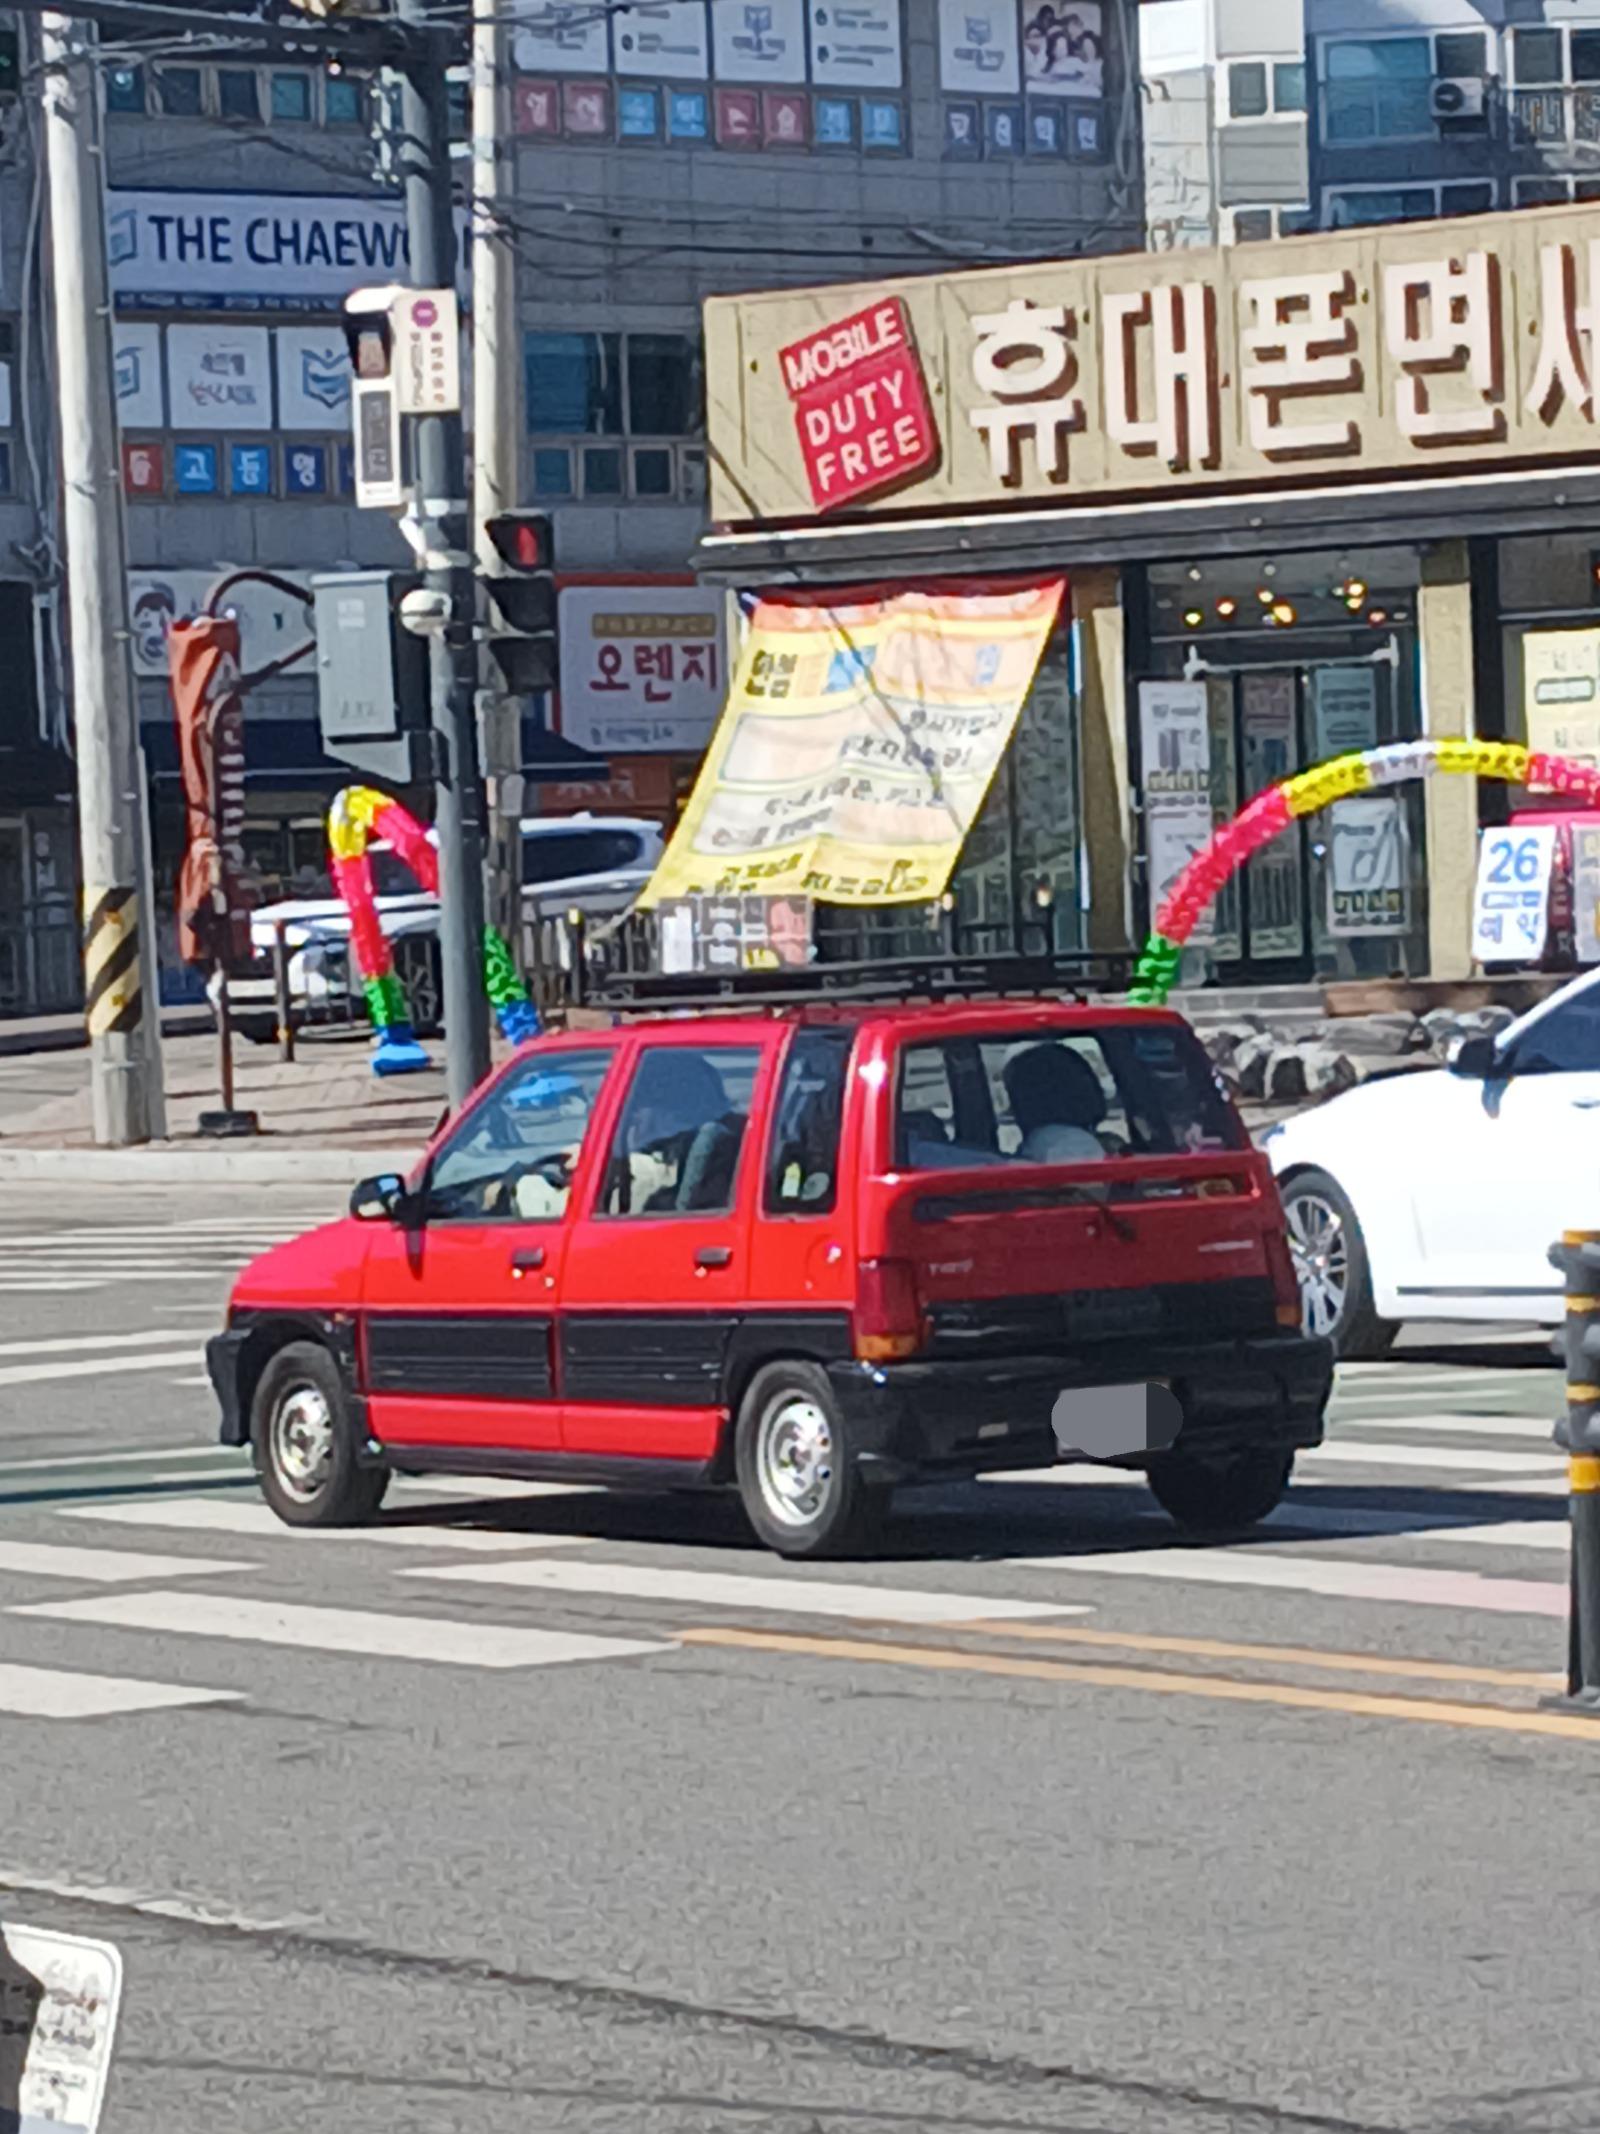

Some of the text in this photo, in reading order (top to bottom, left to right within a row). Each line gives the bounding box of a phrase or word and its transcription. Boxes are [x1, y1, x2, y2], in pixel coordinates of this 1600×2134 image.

[148, 215, 471, 271] THE CHAEW
[784, 307, 903, 391] MOBILE
[804, 369, 904, 447] DUTY
[815, 414, 921, 492] FREE
[588, 643, 717, 703] 오렌지
[1486, 837, 1540, 884] 26
